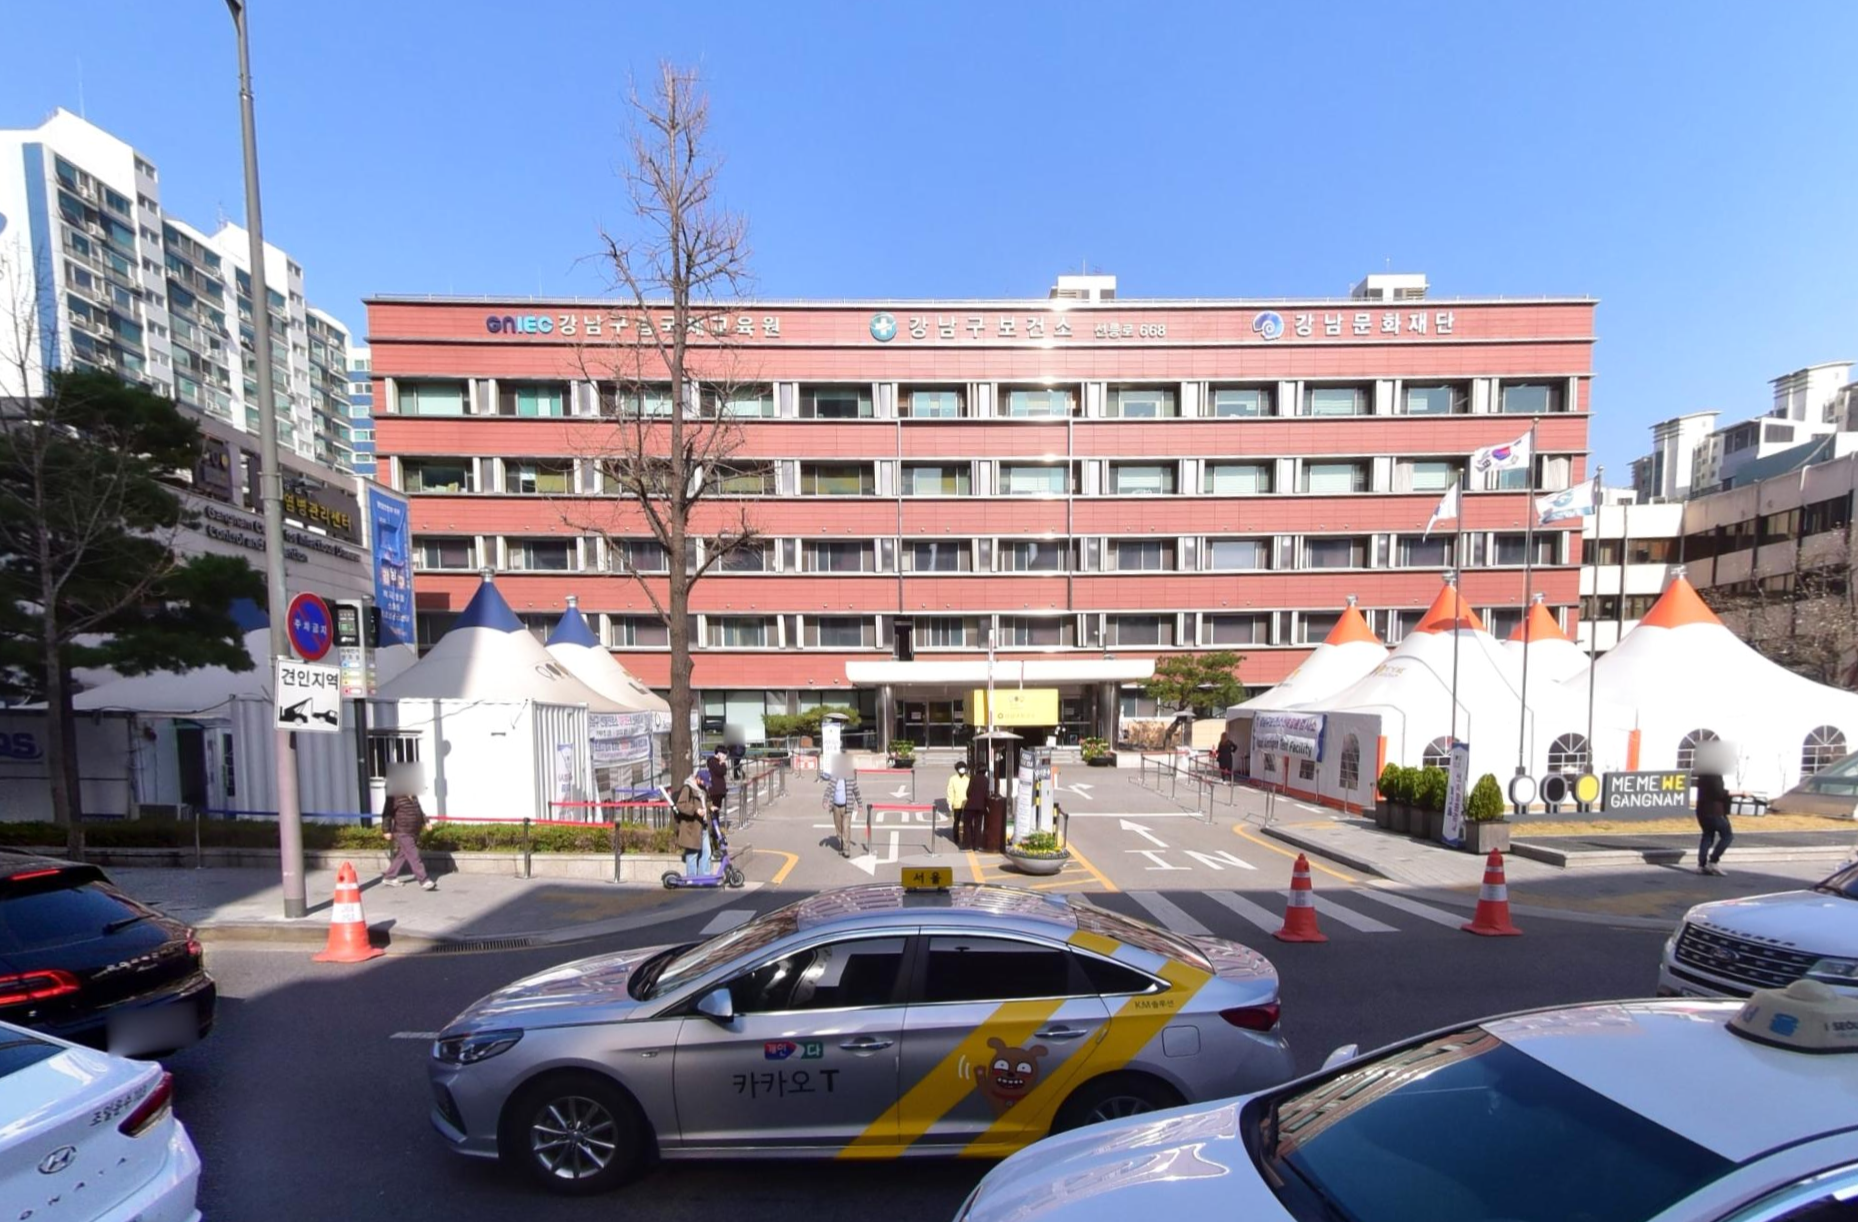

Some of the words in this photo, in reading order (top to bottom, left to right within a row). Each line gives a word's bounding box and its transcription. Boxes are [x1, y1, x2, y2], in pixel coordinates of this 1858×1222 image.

[909, 316, 1073, 339] 강남구보건소
[1139, 323, 1166, 338] 668
[1295, 311, 1455, 336] 강남문화재단
[284, 493, 352, 531] 염병관리센터
[281, 668, 339, 691] 견인지역
[1289, 741, 1313, 758] Facility
[1610, 793, 1685, 808] GANGNAM
[1123, 849, 1259, 871] IN
[912, 871, 942, 885] 서울
[767, 1042, 788, 1057] 개인
[732, 1070, 816, 1099] 카카오
[819, 1069, 840, 1093] T
